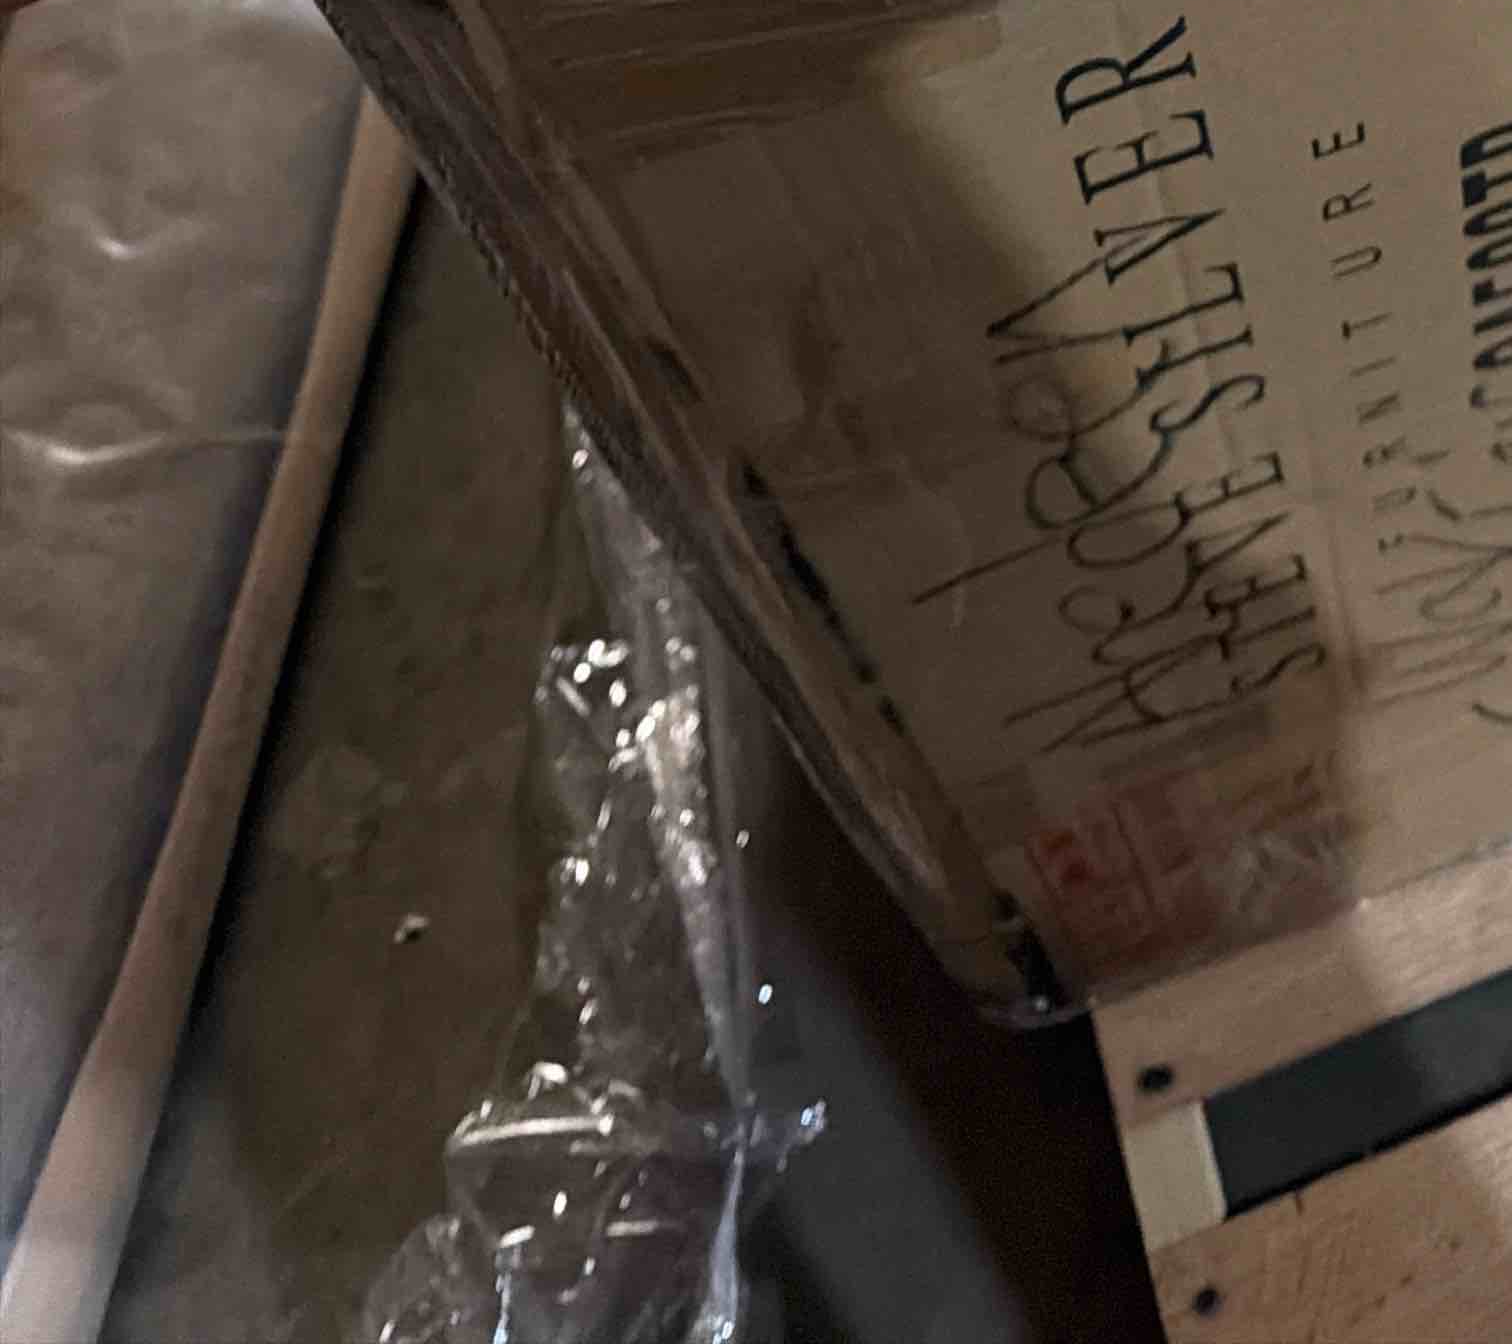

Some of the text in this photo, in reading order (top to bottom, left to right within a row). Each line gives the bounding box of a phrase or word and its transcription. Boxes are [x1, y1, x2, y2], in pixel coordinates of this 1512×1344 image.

[1055, 16, 1265, 436] SILVER
[1311, 121, 1419, 557] FURNITURE
[1174, 450, 1327, 698] STEVE
